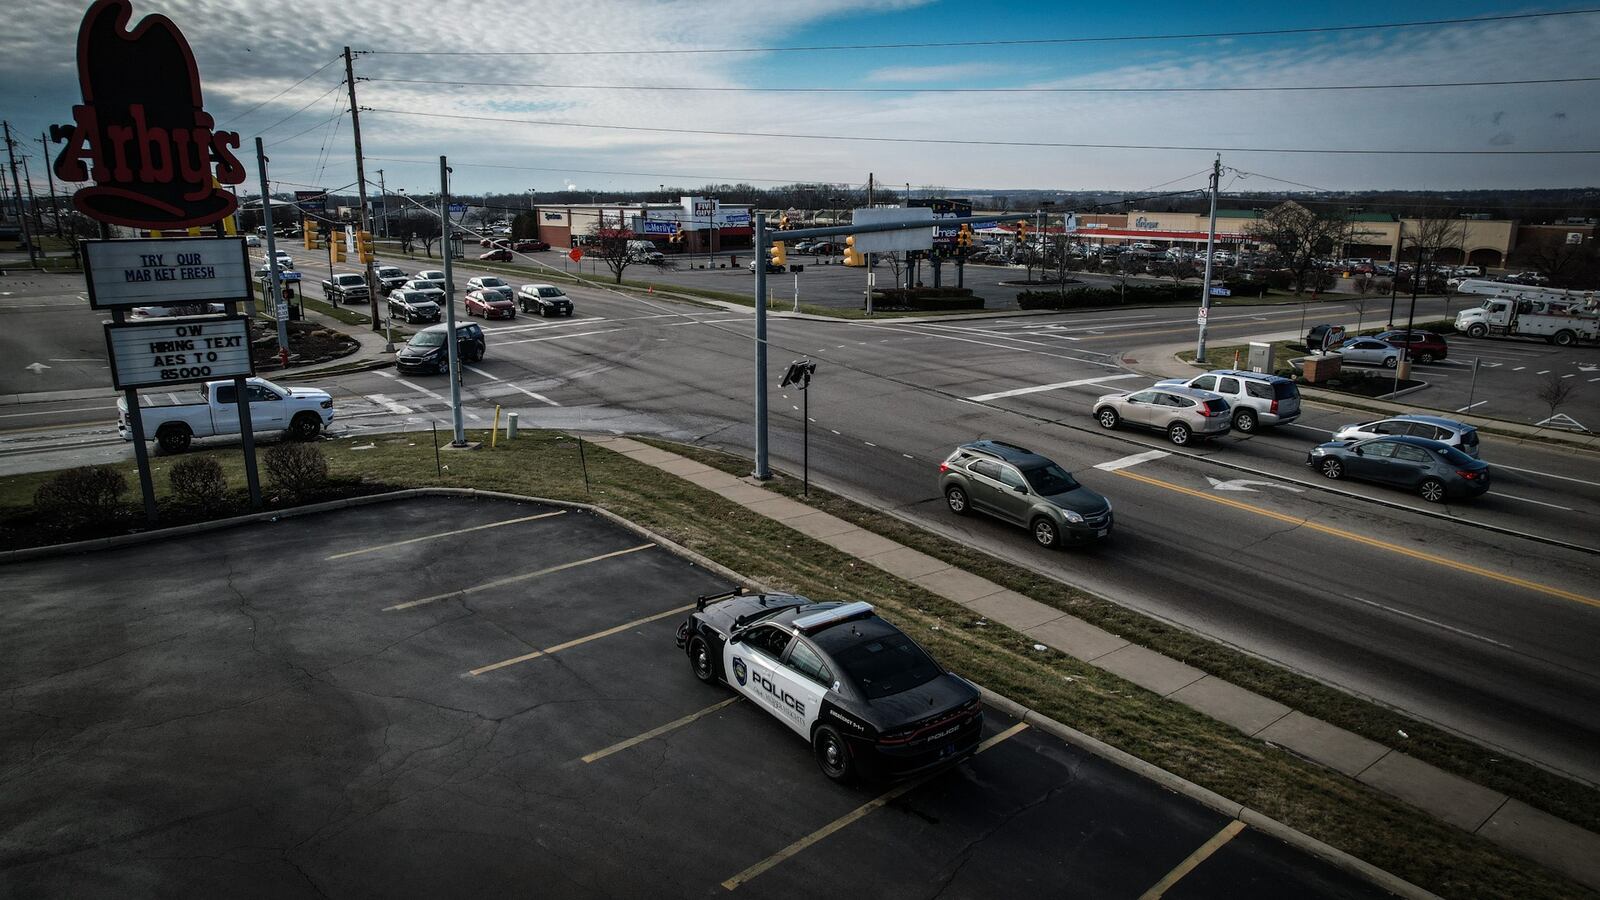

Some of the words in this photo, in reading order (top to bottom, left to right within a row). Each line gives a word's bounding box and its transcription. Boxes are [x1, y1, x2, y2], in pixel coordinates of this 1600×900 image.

[50, 104, 246, 202] Arby's
[140, 254, 164, 267] TRY
[177, 253, 201, 266] OUR
[181, 267, 216, 280] FRESH
[204, 336, 242, 349] TEXT
[154, 354, 186, 367] AES
[161, 366, 211, 379] 85000
[752, 670, 806, 716] POLICE
[927, 724, 960, 742] POLICE
